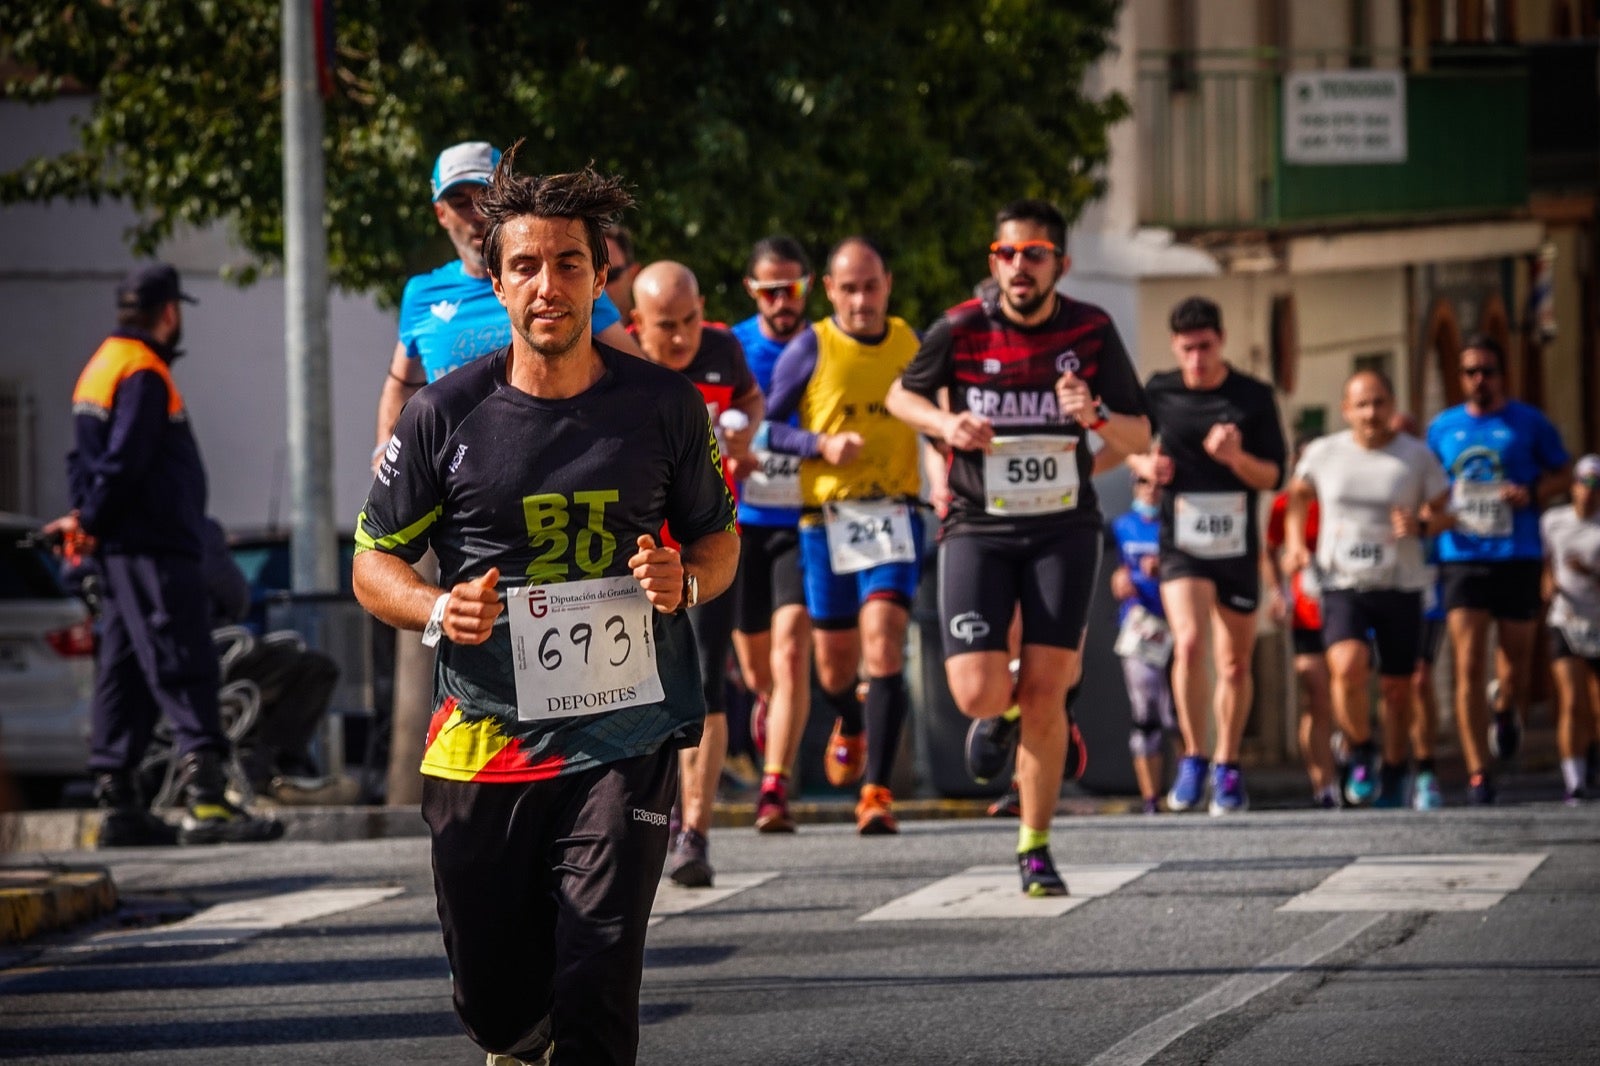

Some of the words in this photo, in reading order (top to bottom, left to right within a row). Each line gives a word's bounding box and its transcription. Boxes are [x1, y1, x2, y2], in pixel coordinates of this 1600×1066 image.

[966, 386, 1066, 417] GRANA
[1007, 456, 1058, 484] 590
[523, 489, 619, 537] BT
[550, 593, 596, 605] Diputación
[597, 590, 607, 599] de
[607, 585, 638, 598] Granada
[538, 614, 631, 671] 693
[547, 686, 637, 712] DEPORTES
[633, 808, 668, 826] Kappa
